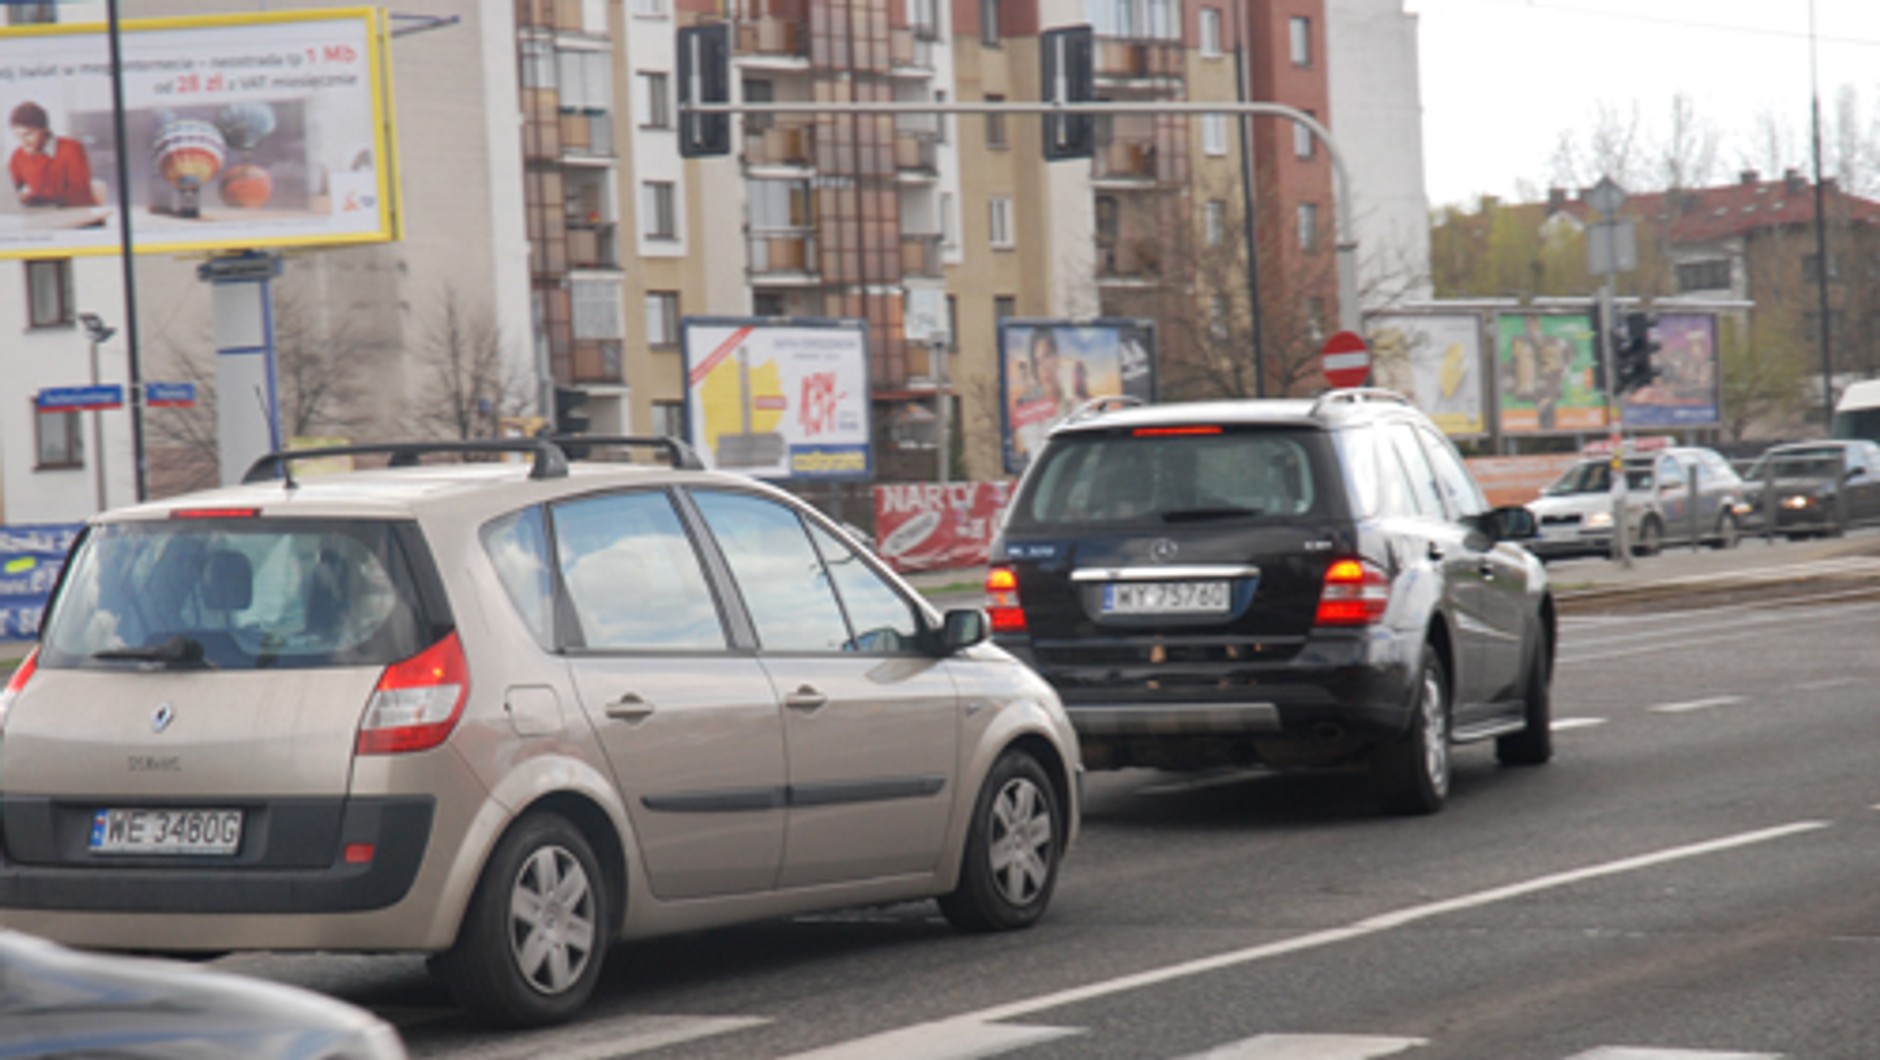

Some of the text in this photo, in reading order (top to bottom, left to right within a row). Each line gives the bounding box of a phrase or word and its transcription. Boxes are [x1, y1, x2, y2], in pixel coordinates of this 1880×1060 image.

[305, 48, 316, 64] 1
[322, 44, 357, 63] Mb
[154, 80, 173, 94] od
[108, 810, 147, 843] WE
